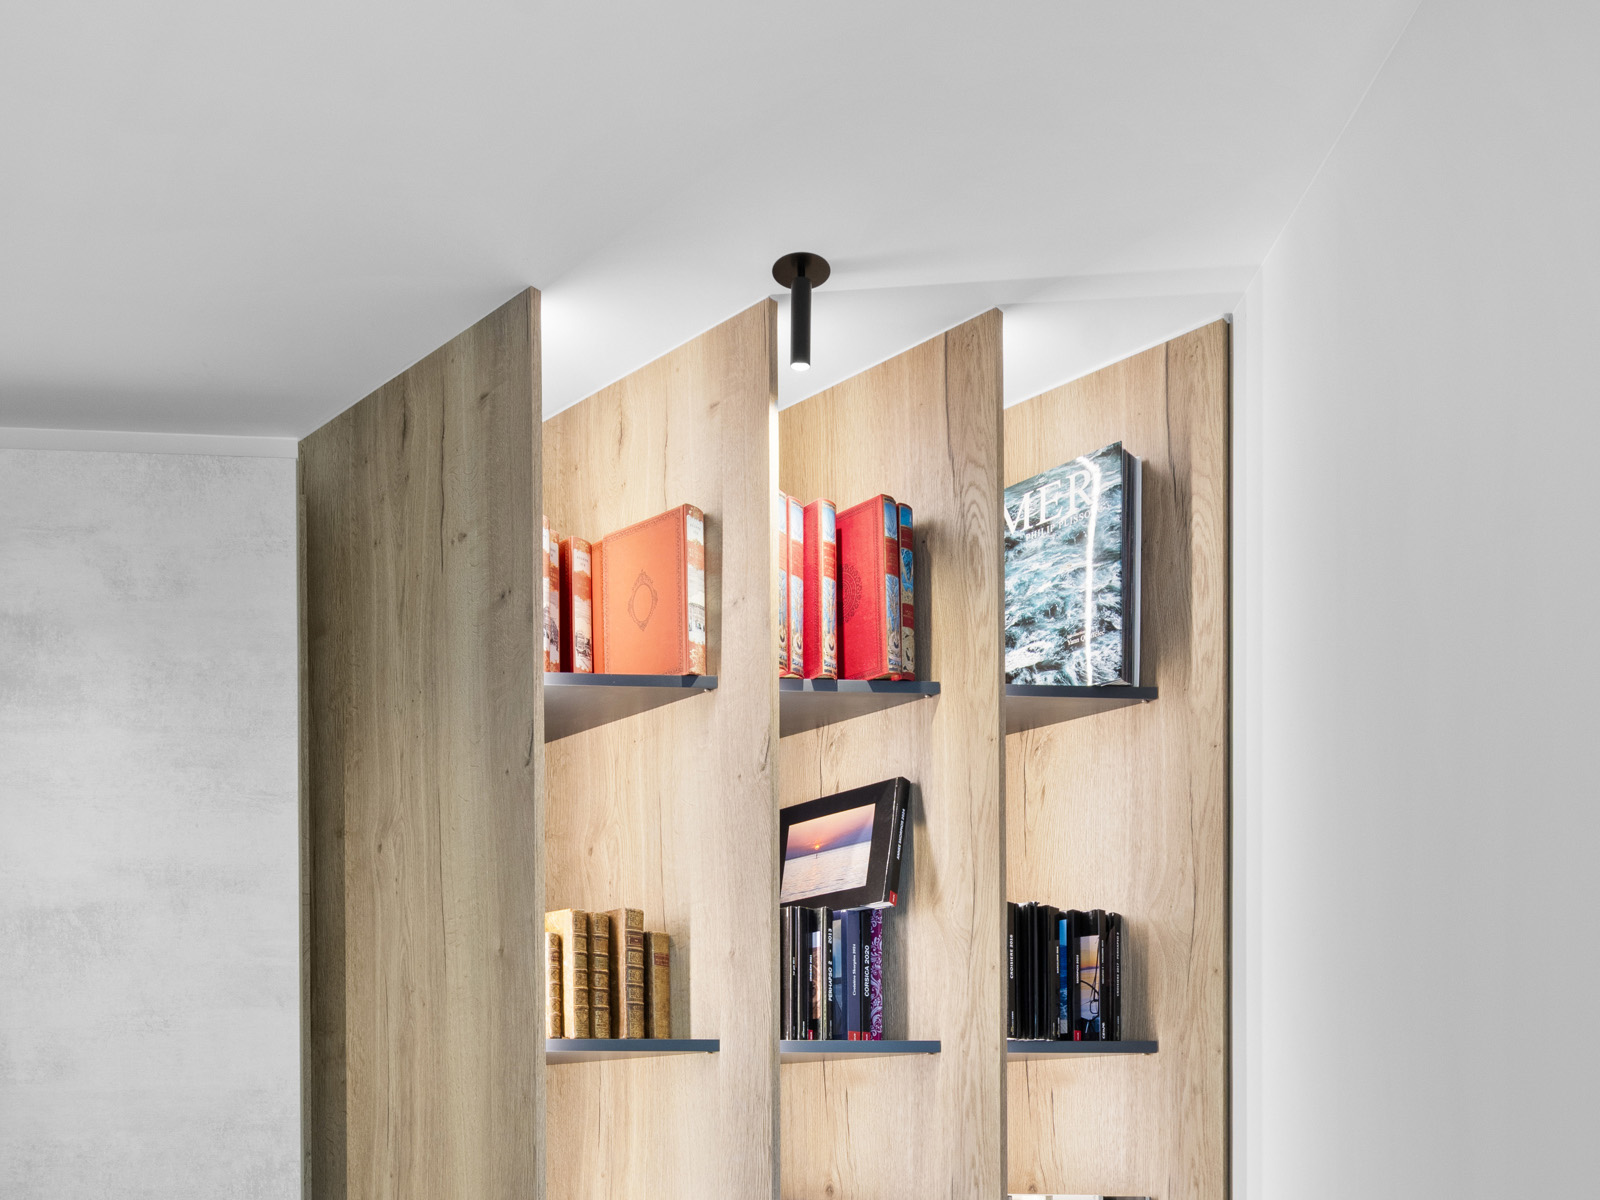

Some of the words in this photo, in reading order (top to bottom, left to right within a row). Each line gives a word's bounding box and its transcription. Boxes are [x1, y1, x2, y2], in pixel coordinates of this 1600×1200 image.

[1004, 469, 1097, 534] MER
[1025, 522, 1056, 541] PHILIP
[1058, 509, 1093, 529] PLISSO
